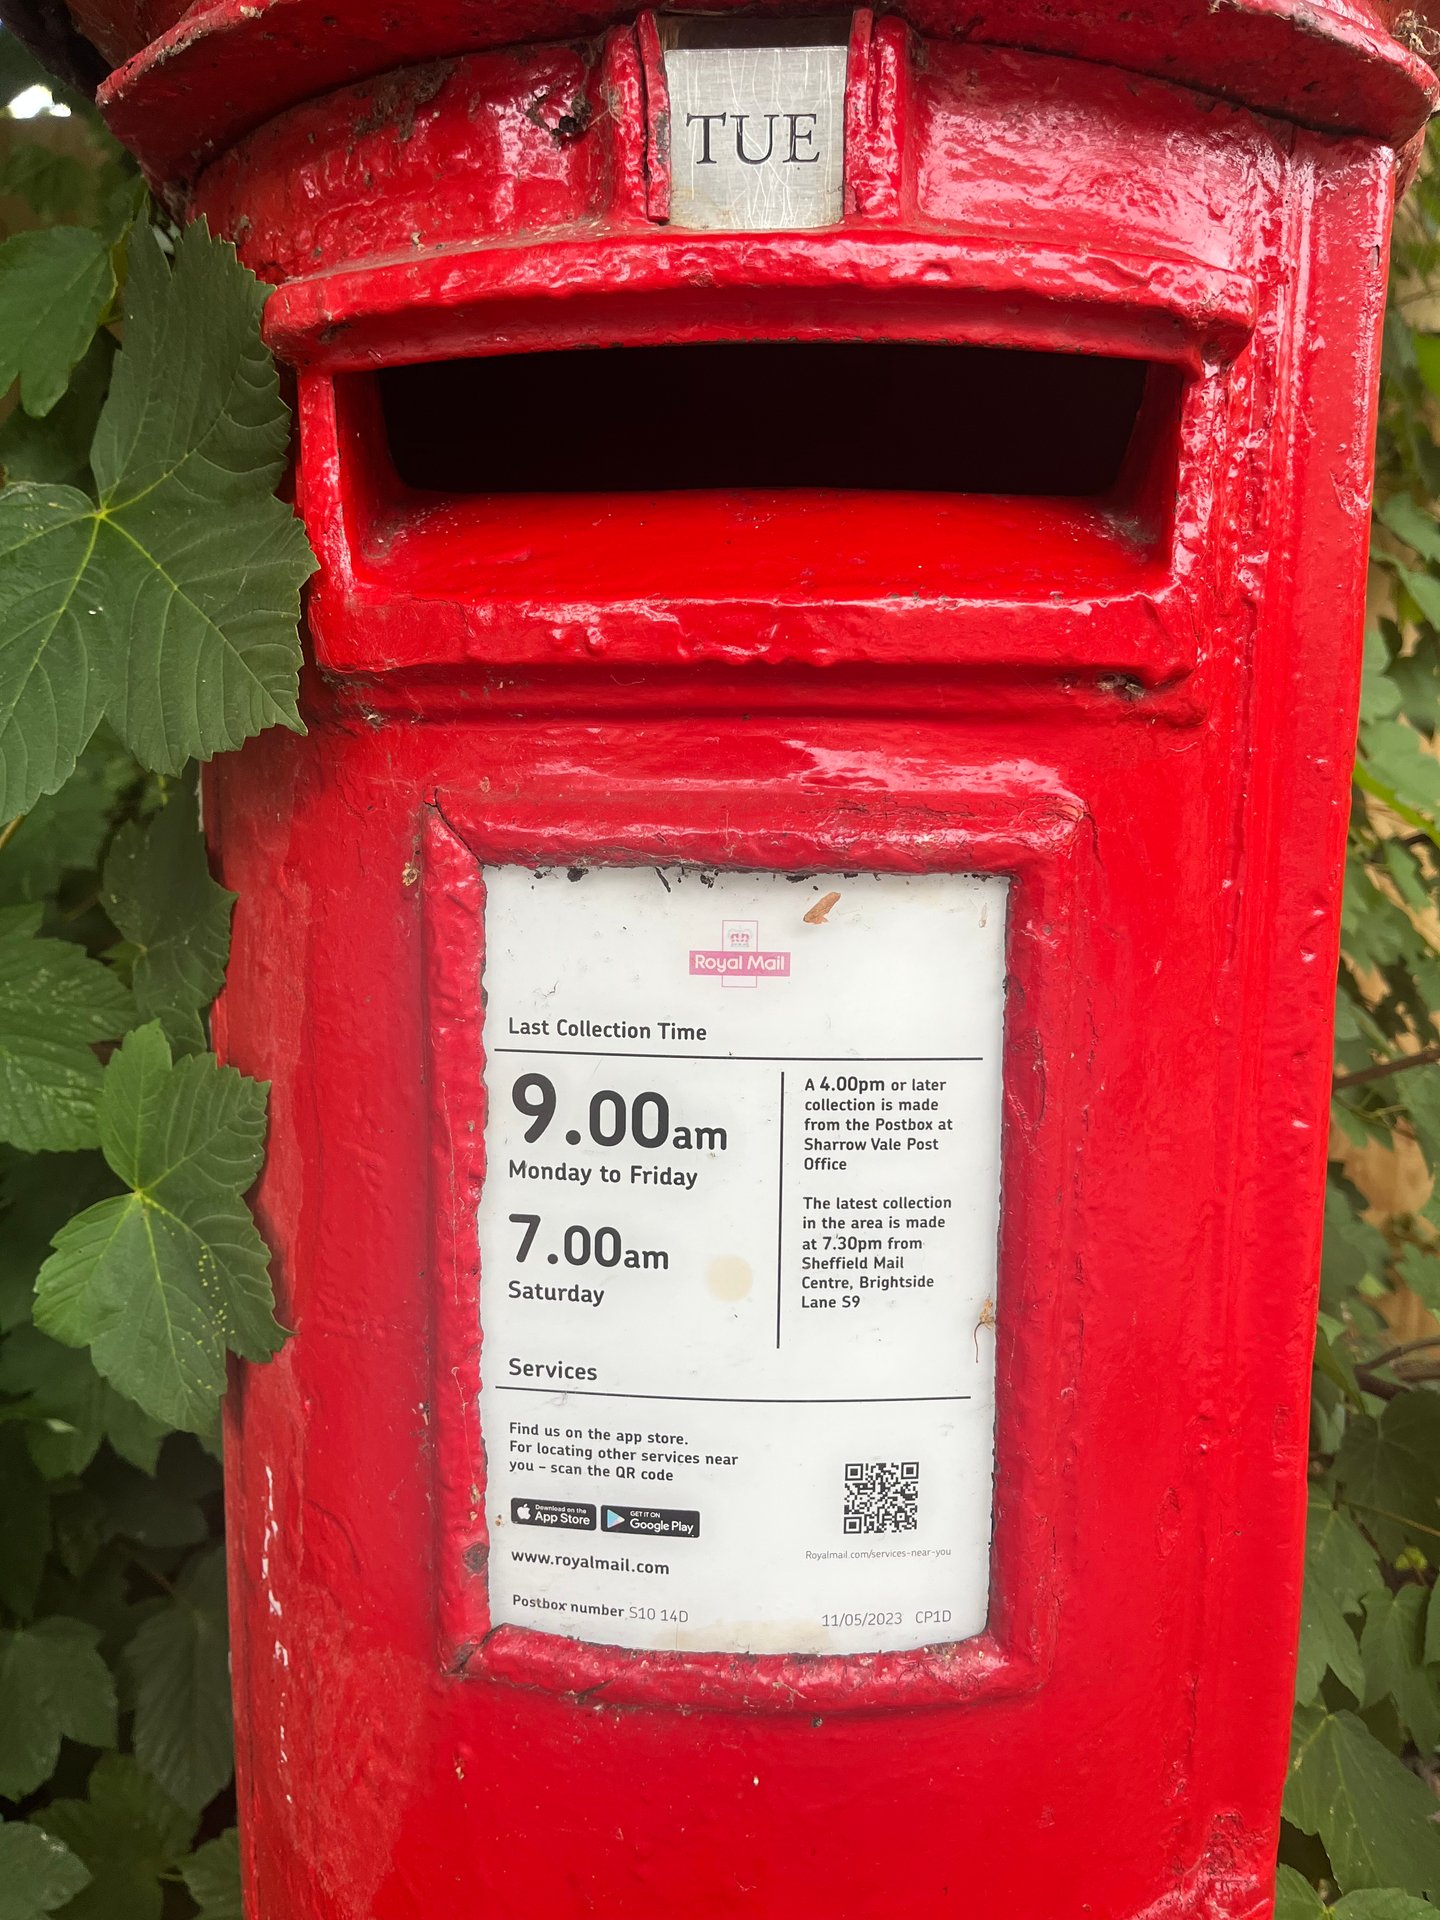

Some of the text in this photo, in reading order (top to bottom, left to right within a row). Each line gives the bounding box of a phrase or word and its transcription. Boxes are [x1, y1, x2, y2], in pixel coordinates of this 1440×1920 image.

[686, 112, 820, 164] TUE
[695, 955, 784, 972] Royal Mail
[510, 1017, 706, 1040] Last Collection Time
[805, 1076, 946, 1094] A 4.00pm or later
[512, 1073, 727, 1150] 9.00am
[805, 1098, 938, 1110] collection is made
[805, 1118, 952, 1130] from the Postbox at
[805, 1138, 938, 1150] Sharrow Vale Post
[805, 1158, 846, 1170] Office
[510, 1160, 697, 1190] Monday to Friday
[803, 1196, 951, 1209] The latest collection
[804, 1216, 945, 1229] in the area is made
[509, 1214, 668, 1269] 7.00am
[803, 1237, 922, 1252] at 7.30pm from
[802, 1256, 903, 1269] Sheffield Mail
[802, 1275, 933, 1290] Centre, Brightside
[509, 1281, 604, 1307] Saturday
[802, 1296, 860, 1308] Lane S9
[509, 1358, 597, 1380] Services
[510, 1422, 688, 1444] Find us on the app store.
[511, 1440, 738, 1465] For locating other services near
[510, 1461, 533, 1472] you
[551, 1465, 581, 1475] scan
[588, 1465, 610, 1477] the
[616, 1467, 635, 1478] QR
[641, 1469, 673, 1480] code
[535, 1511, 590, 1525] App Store
[630, 1518, 694, 1535] Google Play
[512, 1552, 669, 1574] www.royalmail.com
[513, 1595, 688, 1622] Postbox number S10 14D
[822, 1610, 951, 1627] 11/05/2023 CP1D
